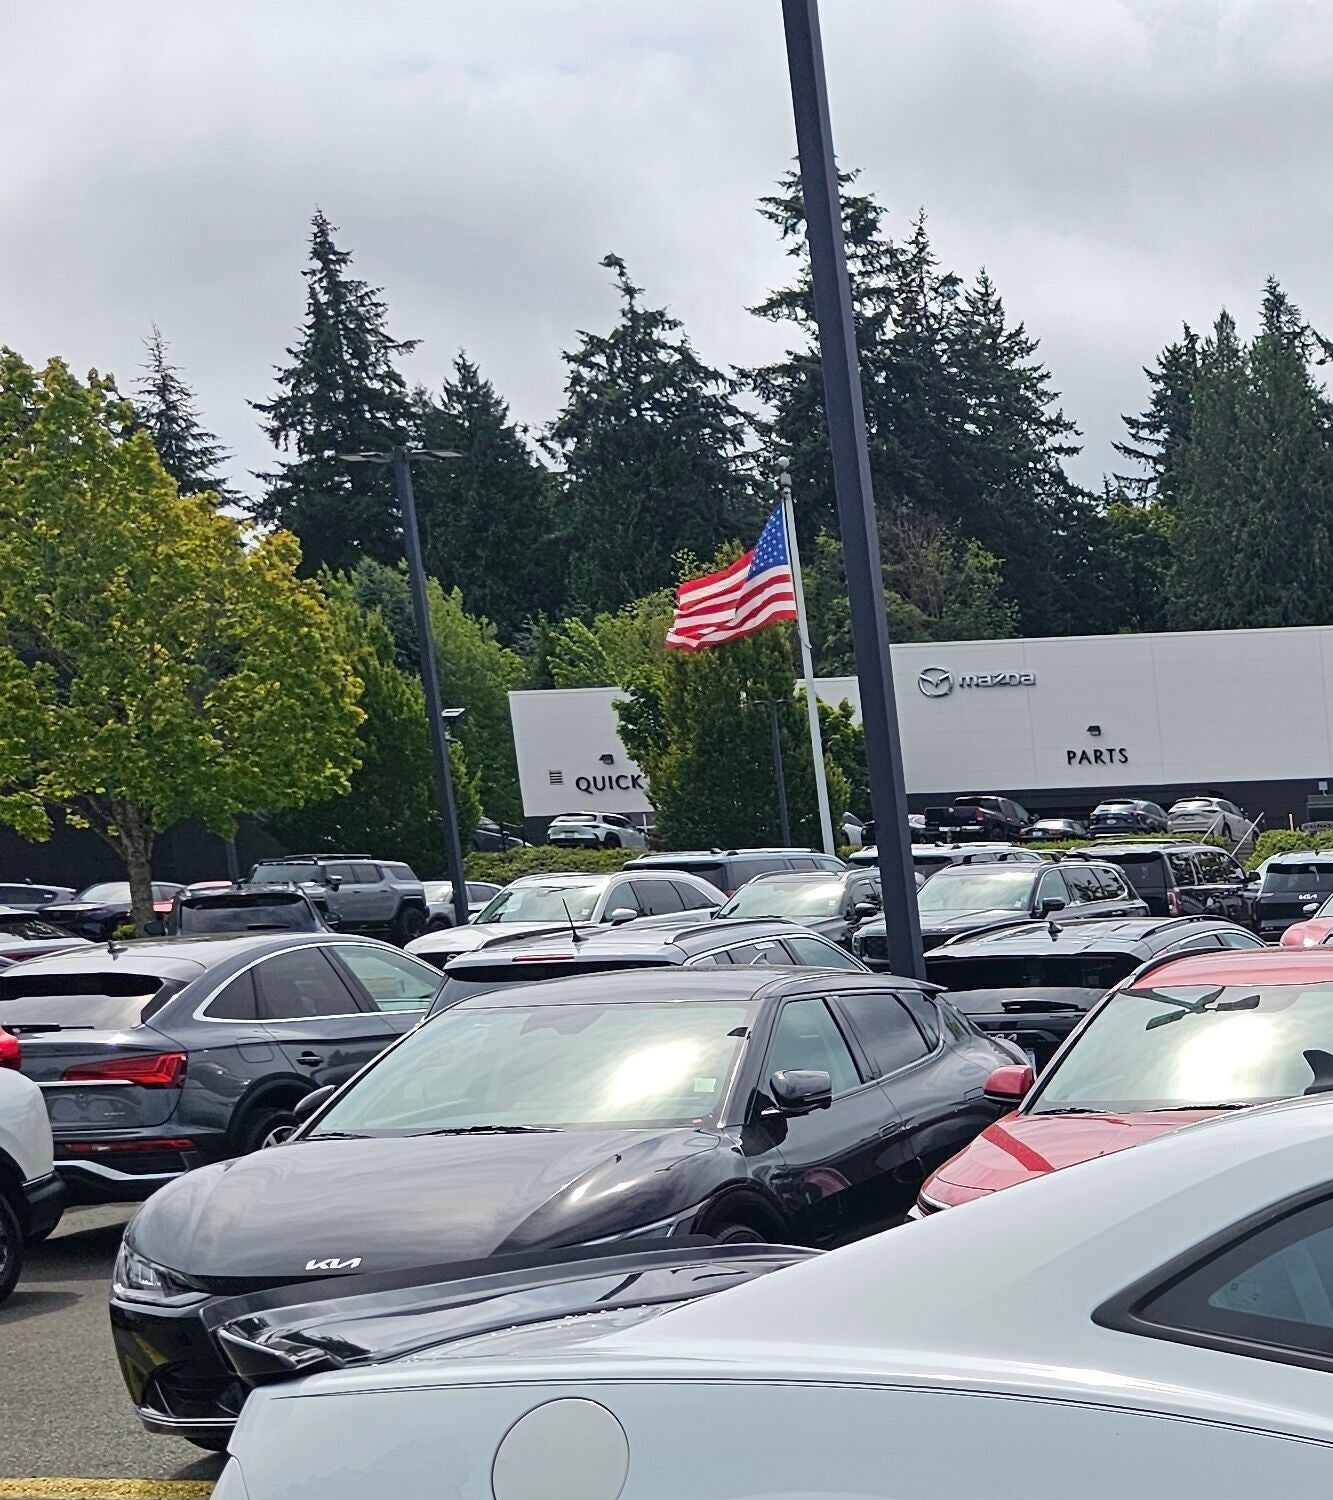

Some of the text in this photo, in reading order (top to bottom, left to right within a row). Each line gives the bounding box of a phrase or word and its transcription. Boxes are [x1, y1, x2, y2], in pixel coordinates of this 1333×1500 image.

[1066, 748, 1129, 765] PARTS
[575, 774, 645, 795] QUICK
[305, 1257, 362, 1270] KIA
